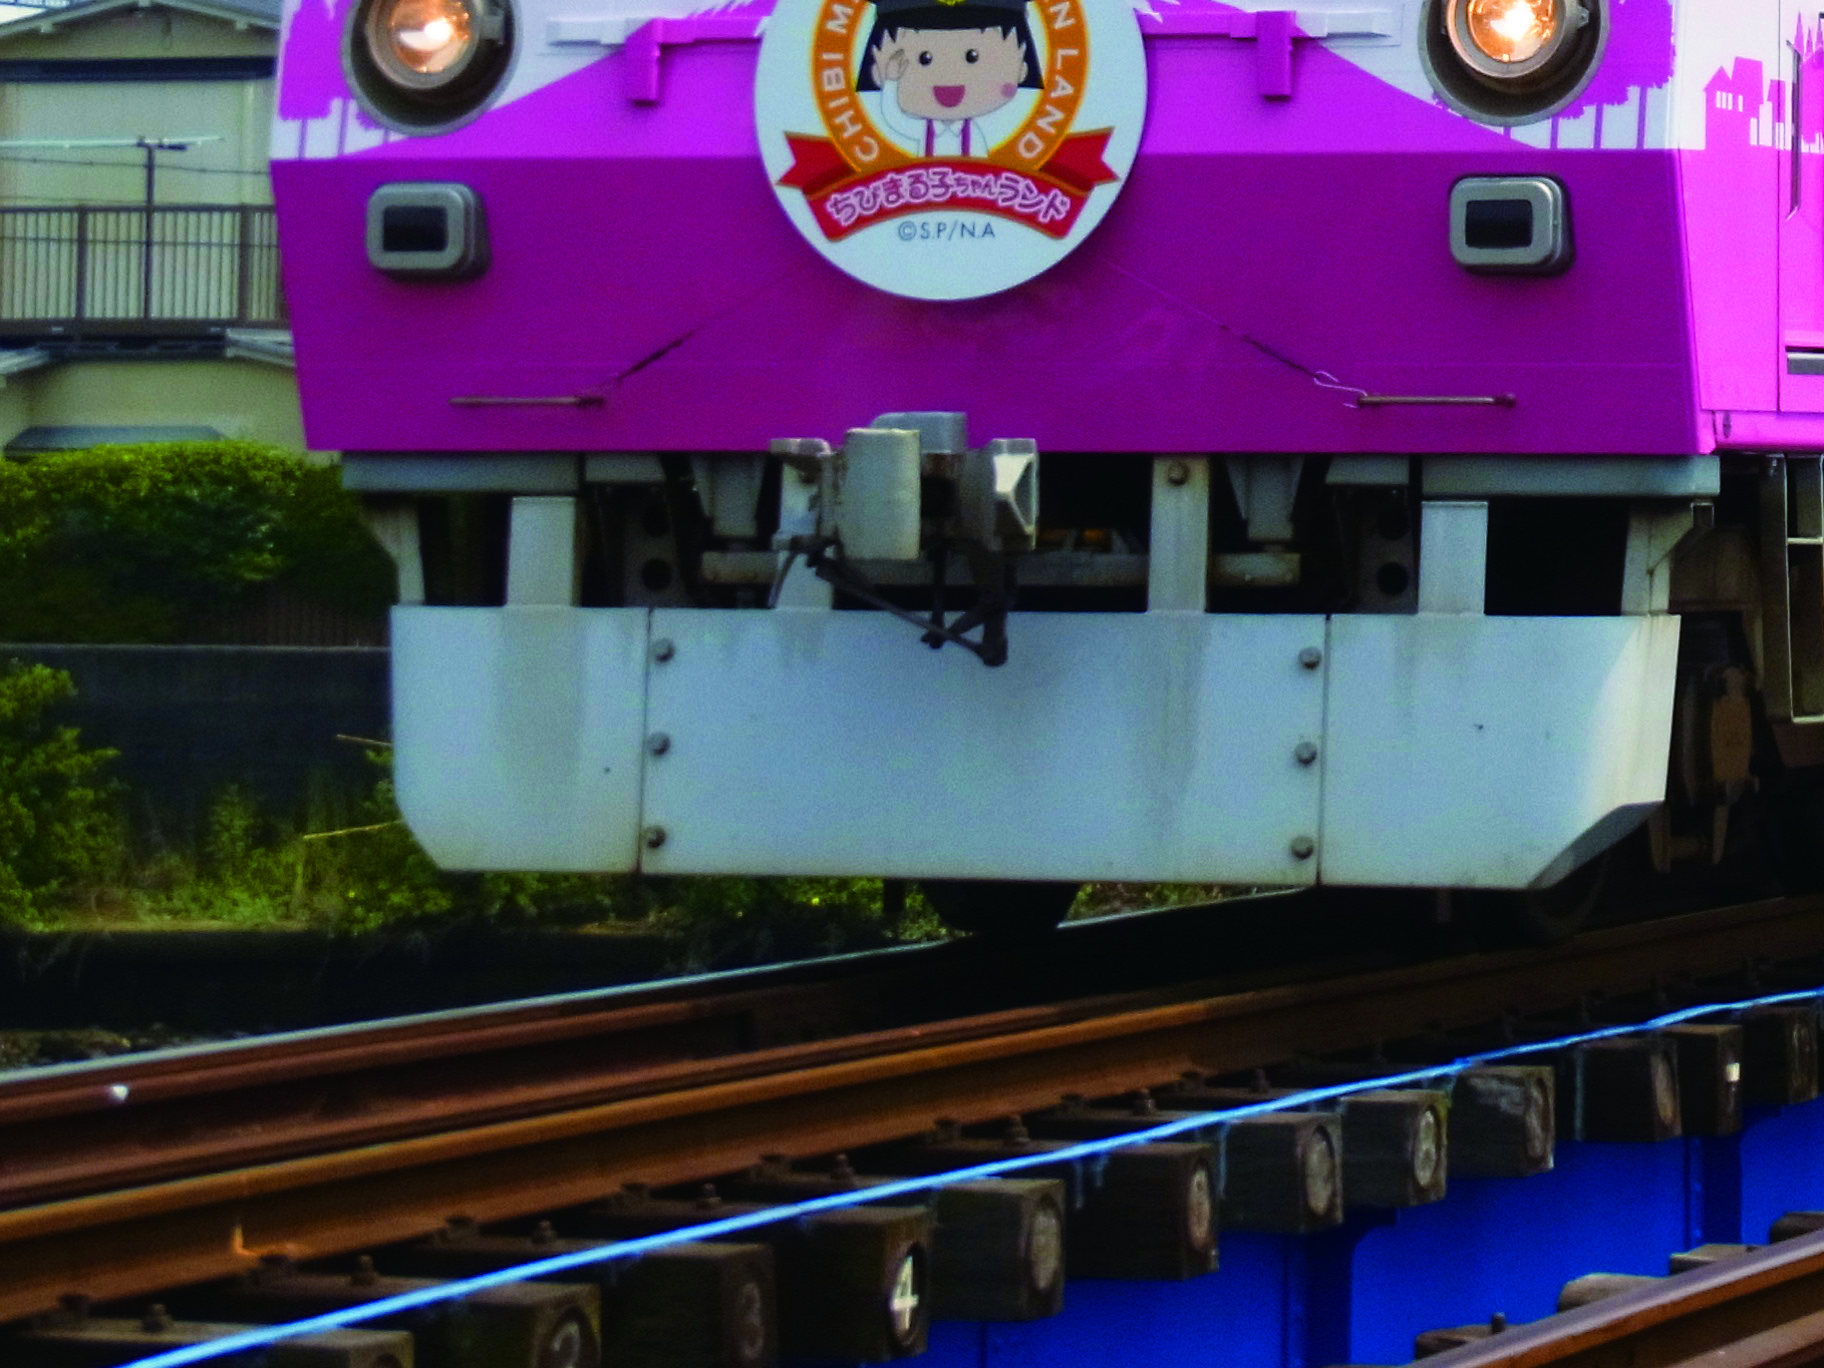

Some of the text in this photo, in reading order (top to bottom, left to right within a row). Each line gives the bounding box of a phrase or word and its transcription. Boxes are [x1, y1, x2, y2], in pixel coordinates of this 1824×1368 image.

[821, 50, 880, 163] CHIBI
[1017, 47, 1079, 159] LAND
[825, 167, 1072, 227] ちびまる子ちゃんランド
